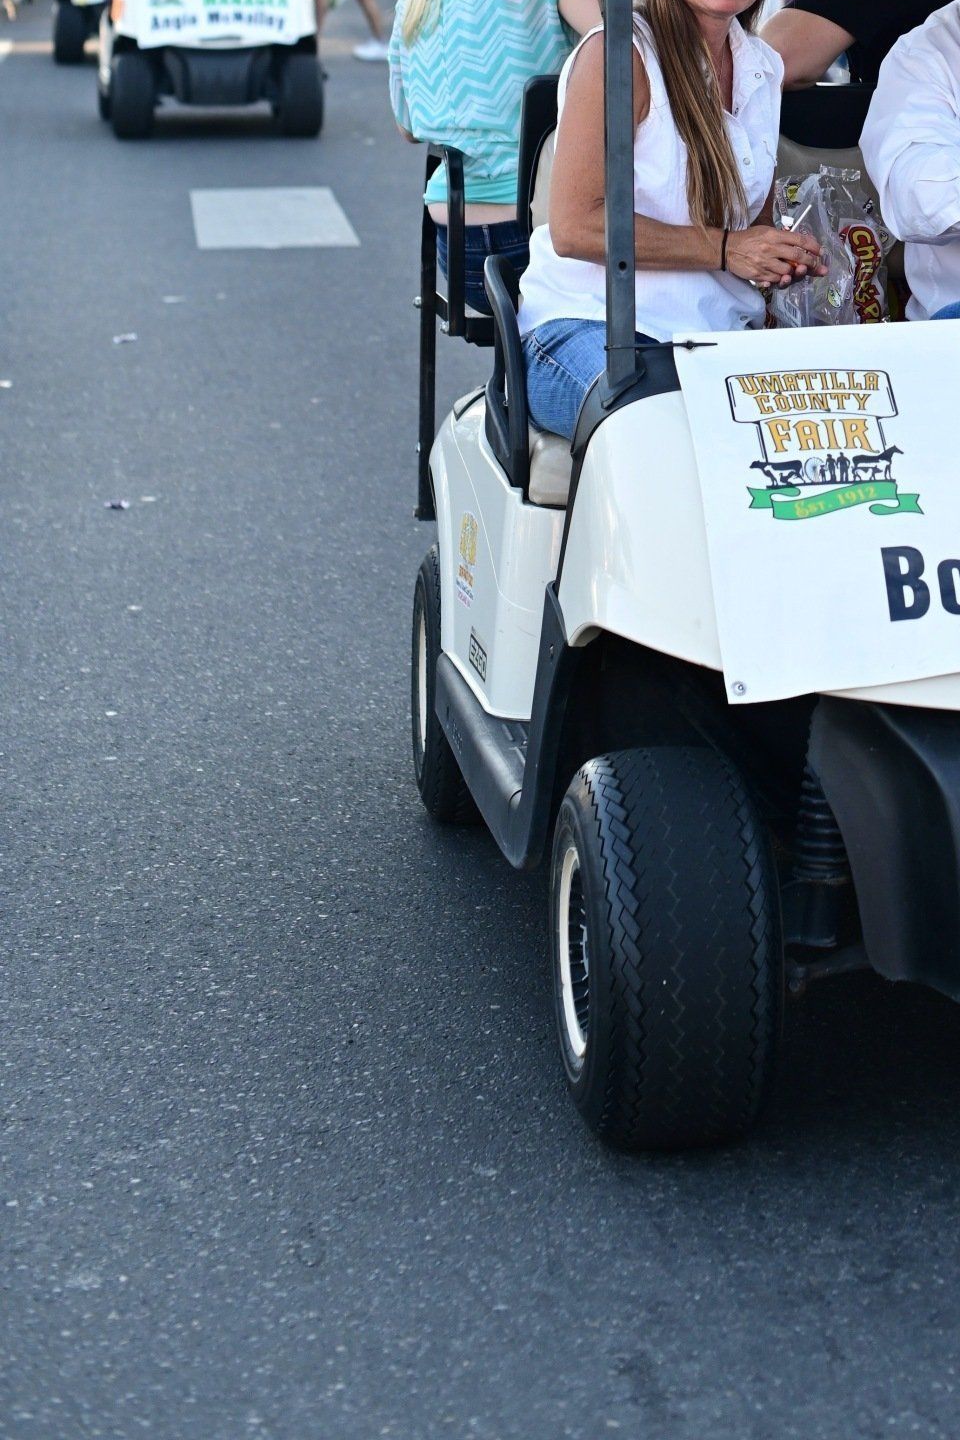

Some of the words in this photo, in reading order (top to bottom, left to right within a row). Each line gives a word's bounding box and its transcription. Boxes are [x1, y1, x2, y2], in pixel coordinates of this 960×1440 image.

[736, 371, 880, 395] UMATILLA
[753, 393, 872, 415] COUNTY
[765, 418, 880, 453] FAIR
[836, 486, 878, 505] 1912
